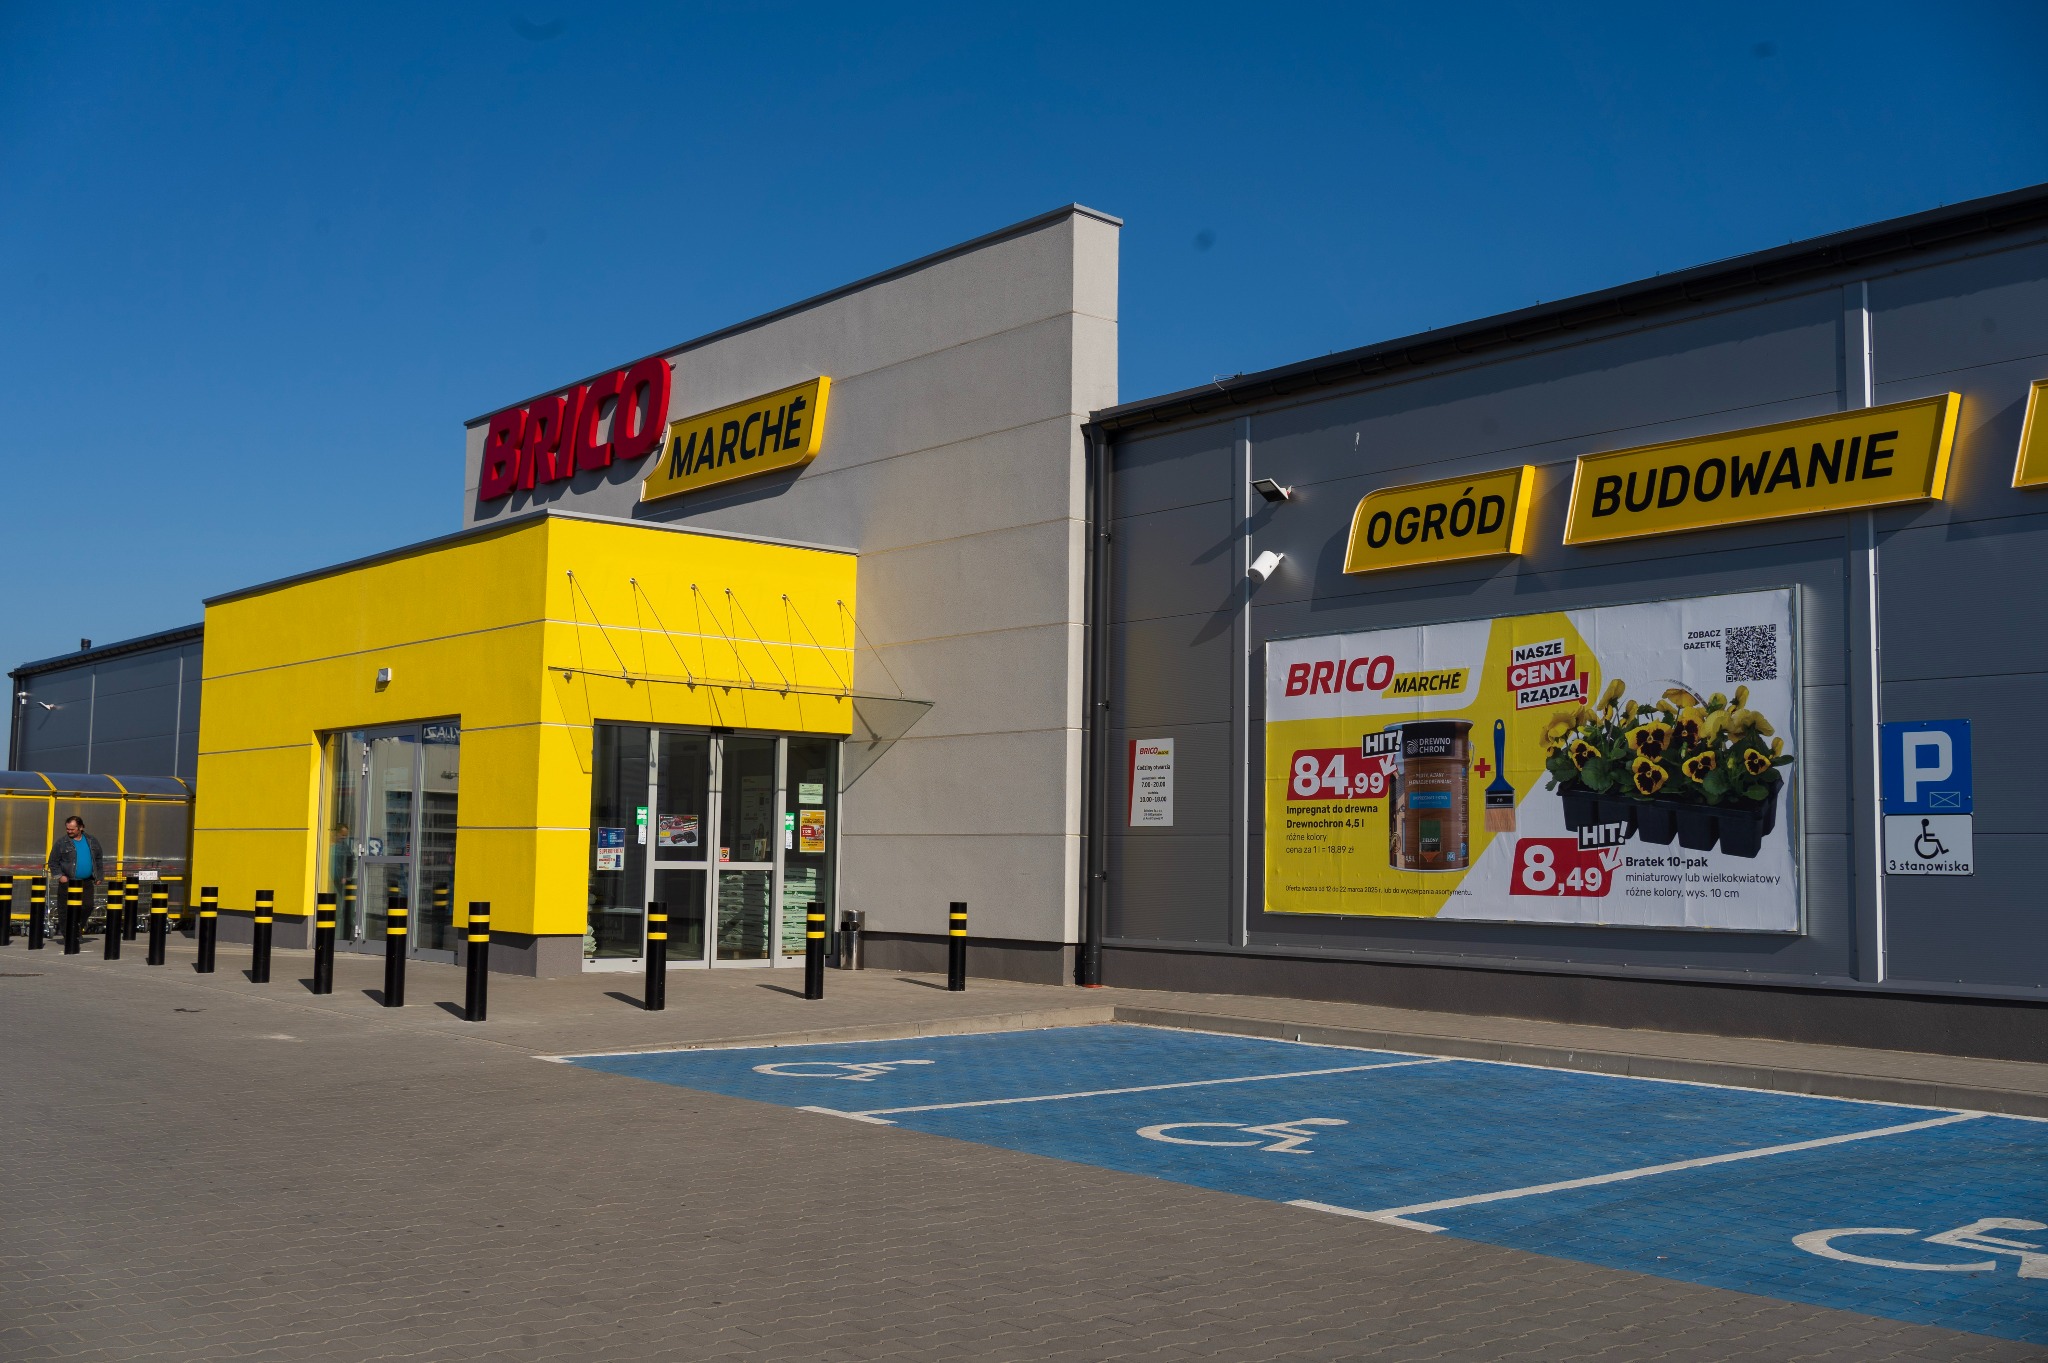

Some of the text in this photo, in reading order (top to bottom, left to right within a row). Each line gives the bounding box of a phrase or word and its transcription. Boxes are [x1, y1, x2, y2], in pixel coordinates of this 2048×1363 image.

[480, 357, 672, 502] BRICO
[668, 396, 806, 480] MARCHÉ
[1592, 430, 1898, 518] BUDOWANIE
[1367, 487, 1505, 548] OGRÓD
[1688, 630, 1721, 639] ZOBACZ
[1516, 642, 1561, 661] NASZE
[1684, 640, 1721, 650] GAZETKĘ
[1285, 655, 1394, 697] BRICO
[1511, 659, 1571, 687] CENY
[1394, 671, 1461, 693] MARCHÉ
[1364, 730, 1403, 753] HIT!
[1419, 738, 1451, 746] DREWNO
[1419, 745, 1445, 753] CHRON
[1140, 747, 1158, 755] BRICO
[1902, 730, 1953, 803] P
[1293, 754, 1384, 799] 84,99
[1286, 803, 1378, 816] Impregnat do drewna
[1286, 818, 1343, 829] Drewnochron
[1345, 818, 1360, 828] 4,5
[1286, 832, 1328, 842] różne kolory
[1582, 820, 1629, 846] HIT!
[1303, 846, 1312, 854] za
[1522, 844, 1603, 896] 8,49
[1625, 857, 1708, 869] Bratek 10-pak
[1889, 860, 1969, 872] 3 stanowiska
[1625, 872, 1780, 885] miniaturowy lub wielkokwiatowy
[1625, 887, 1740, 899] różne kolory, wys. 10 cm
